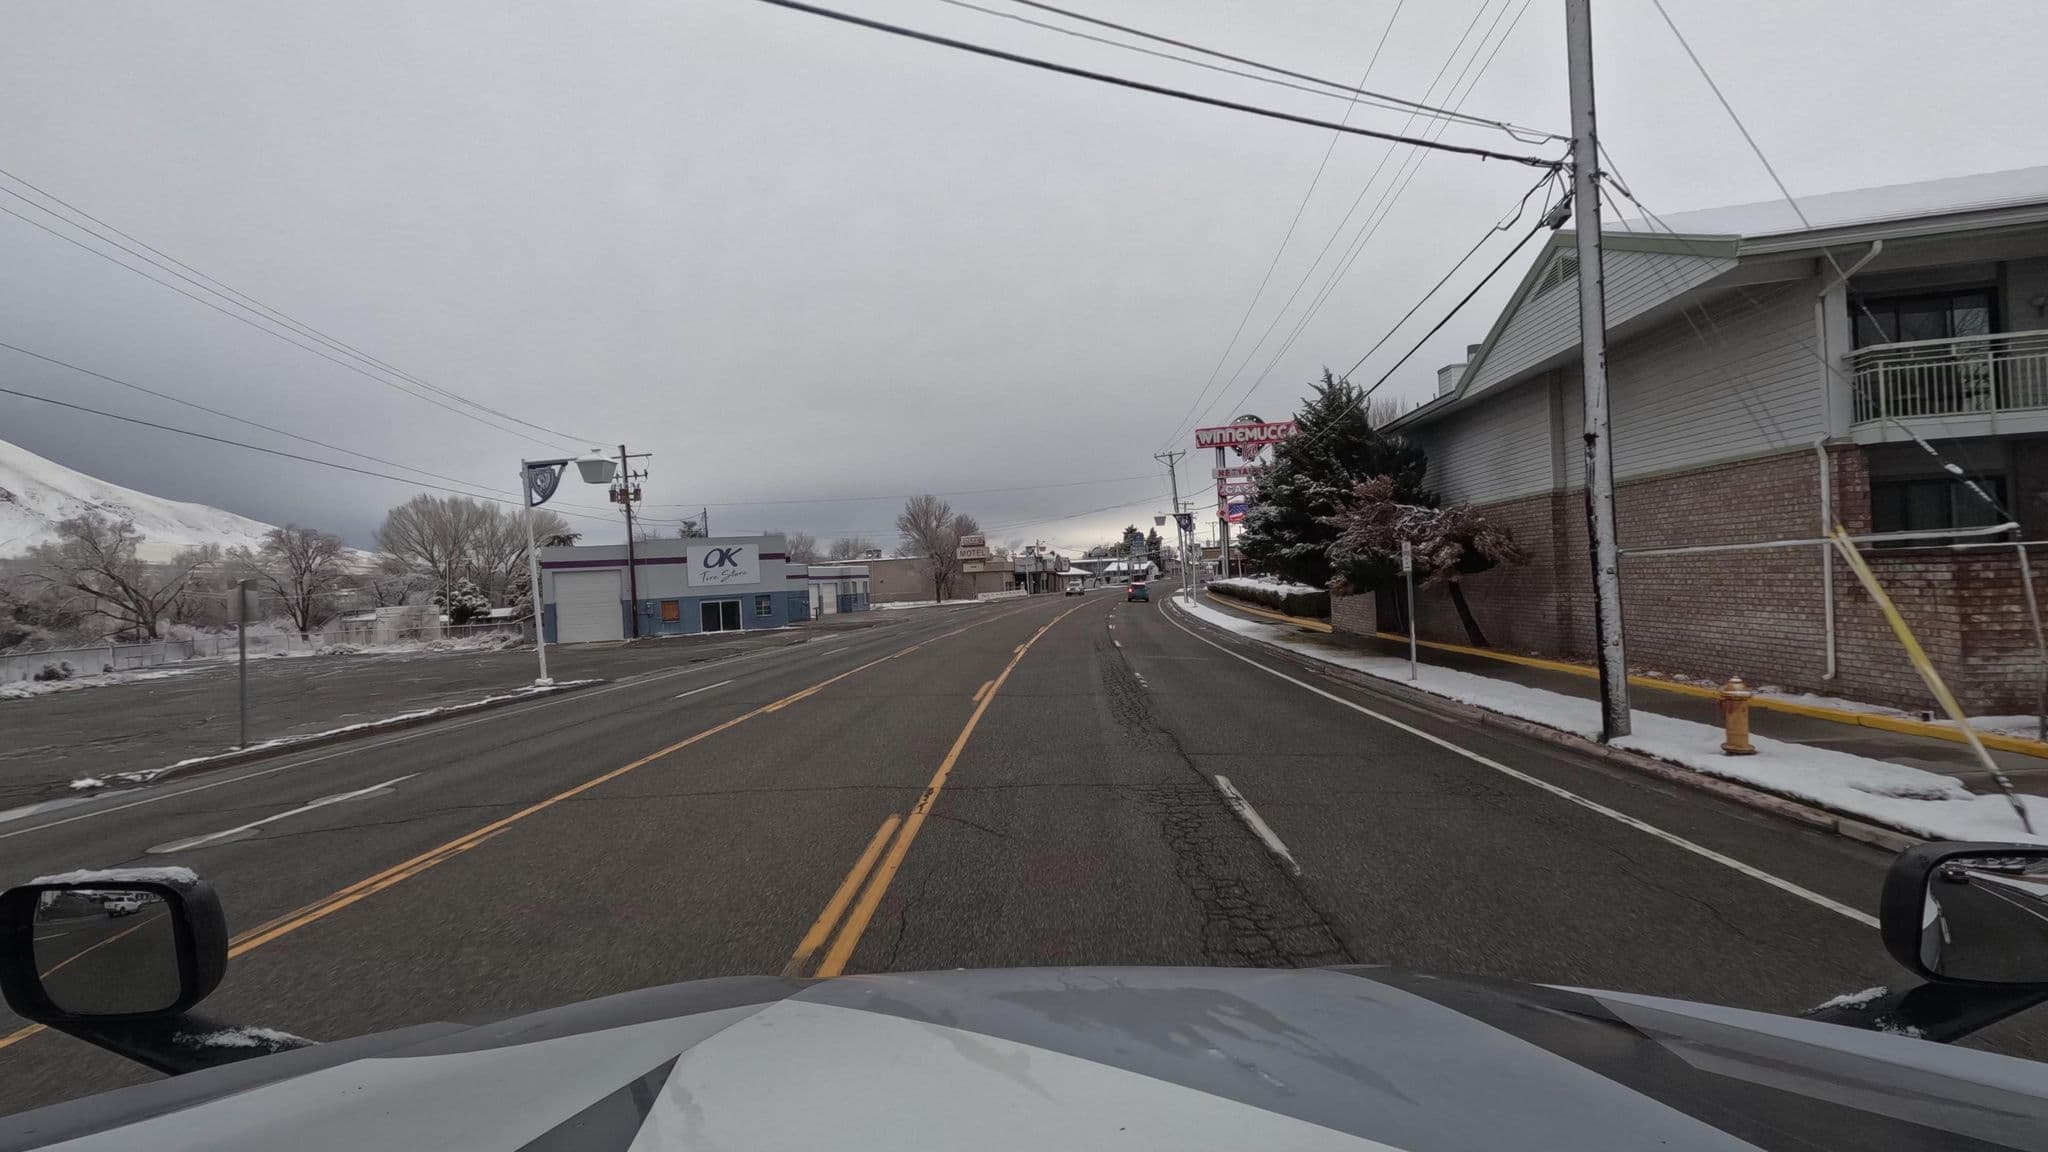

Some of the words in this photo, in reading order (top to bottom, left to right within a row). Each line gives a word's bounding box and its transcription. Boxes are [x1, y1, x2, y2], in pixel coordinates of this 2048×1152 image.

[1198, 425, 1298, 445] WINNEMUCCA
[703, 548, 743, 569] OK
[959, 549, 986, 557] MOTEL
[699, 570, 719, 584] Tire
[721, 569, 747, 583] Store
